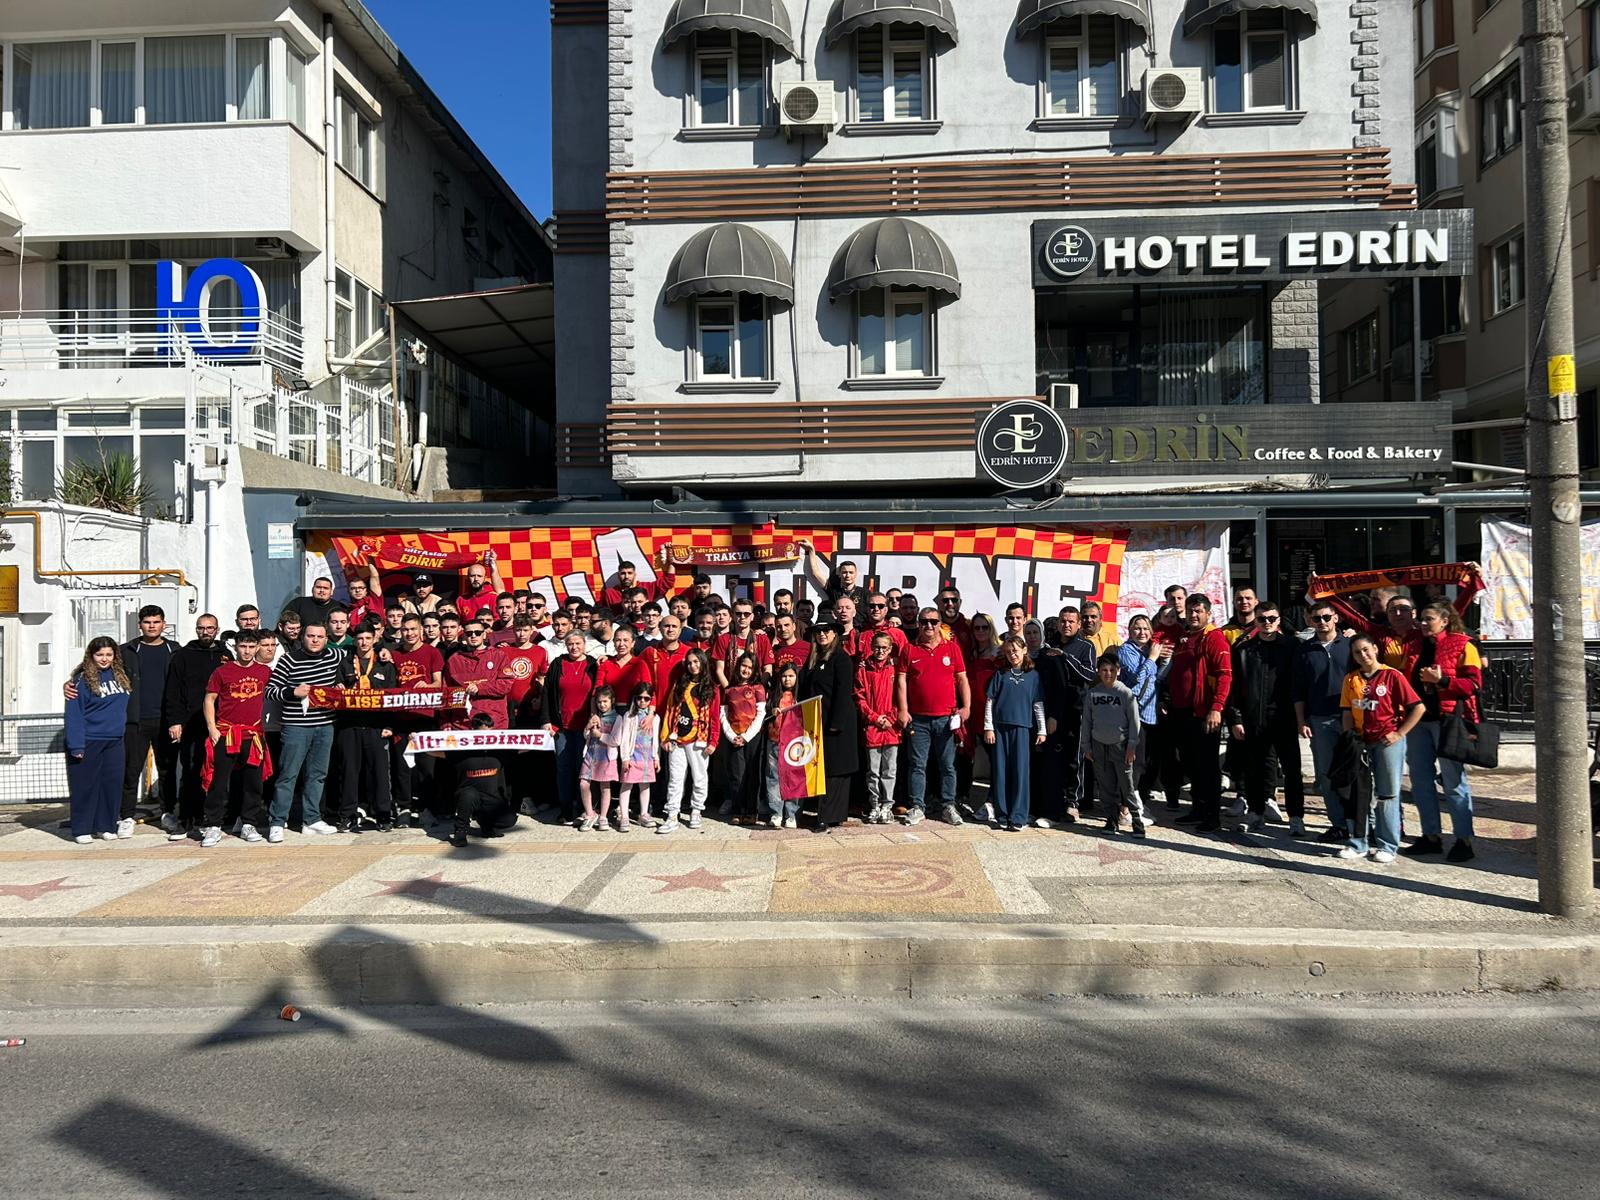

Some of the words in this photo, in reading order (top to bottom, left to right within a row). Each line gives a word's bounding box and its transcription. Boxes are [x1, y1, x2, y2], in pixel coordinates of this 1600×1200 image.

[1103, 234, 1271, 270] HOTEL
[1286, 221, 1449, 266] EDRİN
[1071, 413, 1251, 464] EDRİN
[990, 454, 1020, 466] EDRİN
[1022, 456, 1056, 465] HOTEL
[1254, 447, 1305, 460] Coffee
[1309, 447, 1323, 460] &
[1327, 446, 1363, 460] Food
[1366, 446, 1380, 459] &
[1384, 446, 1443, 461] Bakery
[400, 553, 446, 568] EDİRNE
[705, 551, 750, 562] TRAKYA
[345, 696, 381, 708] LISE
[383, 691, 443, 708] EDİRNE
[1092, 695, 1122, 706] USPA
[473, 731, 545, 746] EDİRNE
